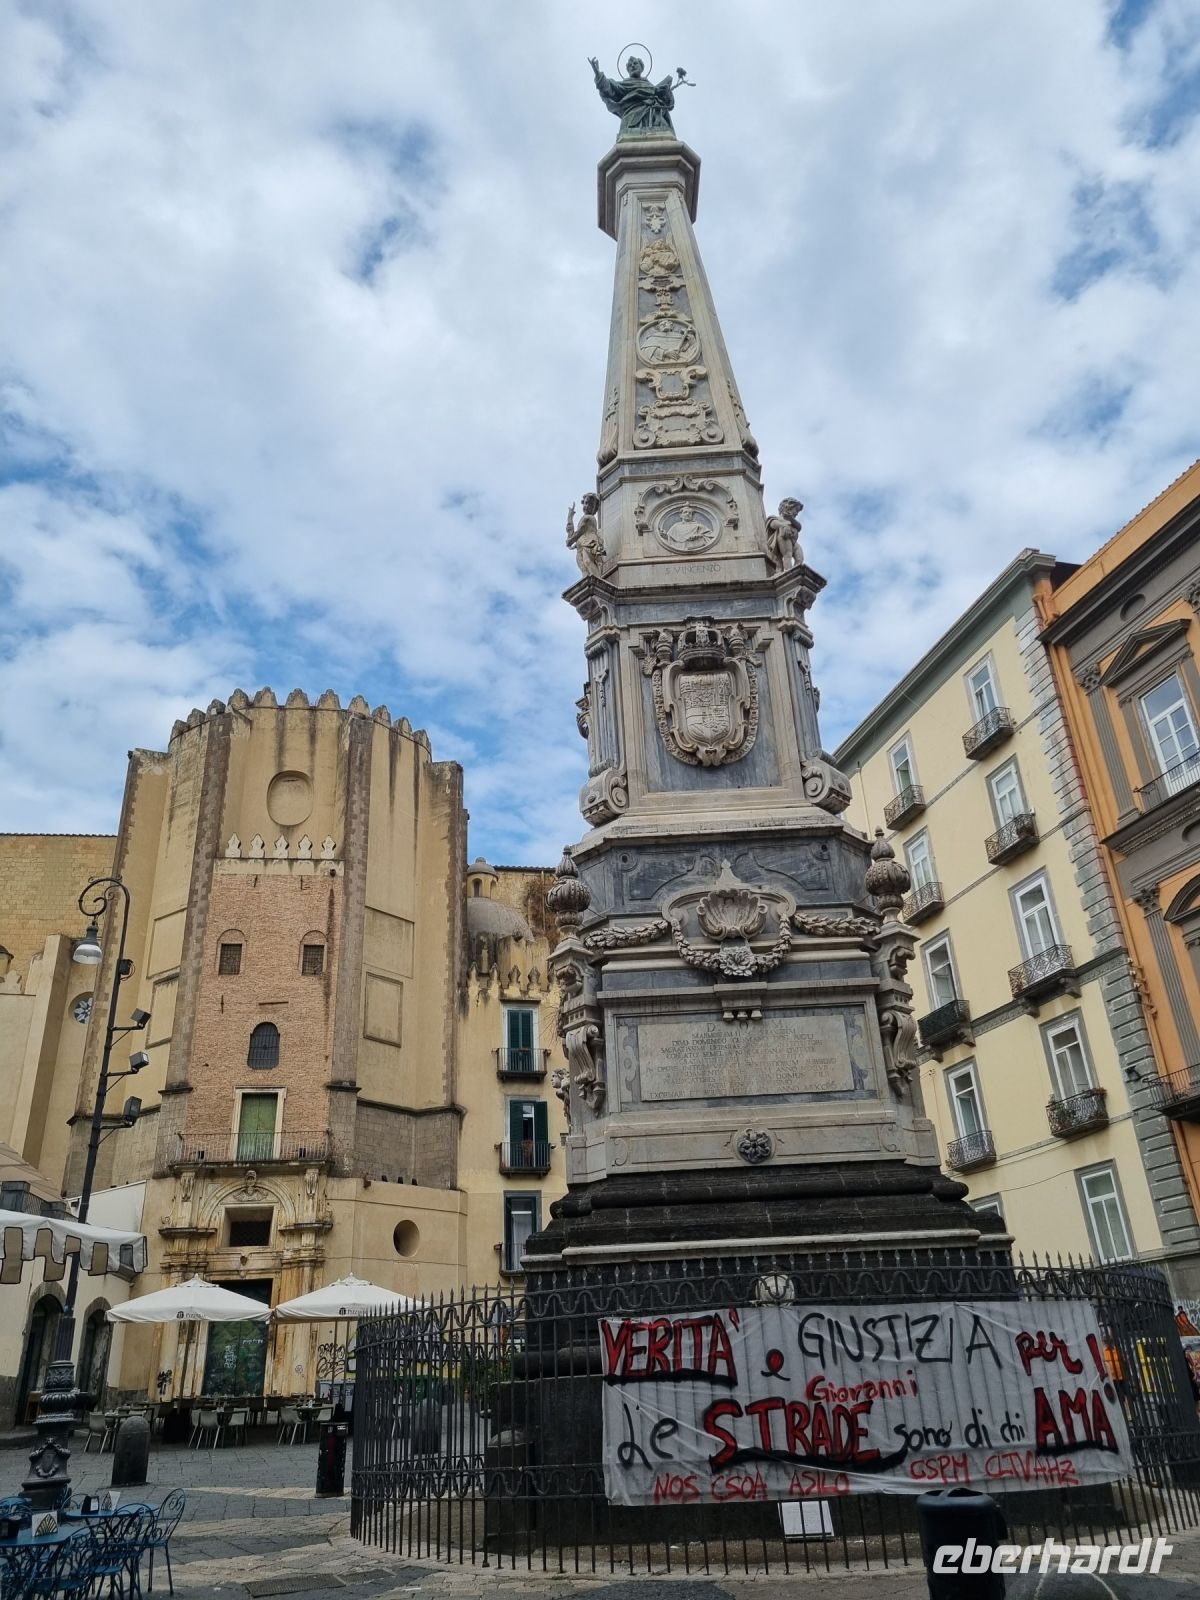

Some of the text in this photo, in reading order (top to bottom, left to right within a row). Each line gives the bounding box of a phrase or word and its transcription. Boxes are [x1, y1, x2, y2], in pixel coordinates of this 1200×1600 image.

[798, 1312, 1003, 1370] GIUSTIZIA
[806, 1369, 918, 1401] Giovanni
[617, 1386, 1119, 1474] Le STRADE sono di chi AMA
[653, 1471, 701, 1504] NOS
[789, 1470, 850, 1497] ASILO
